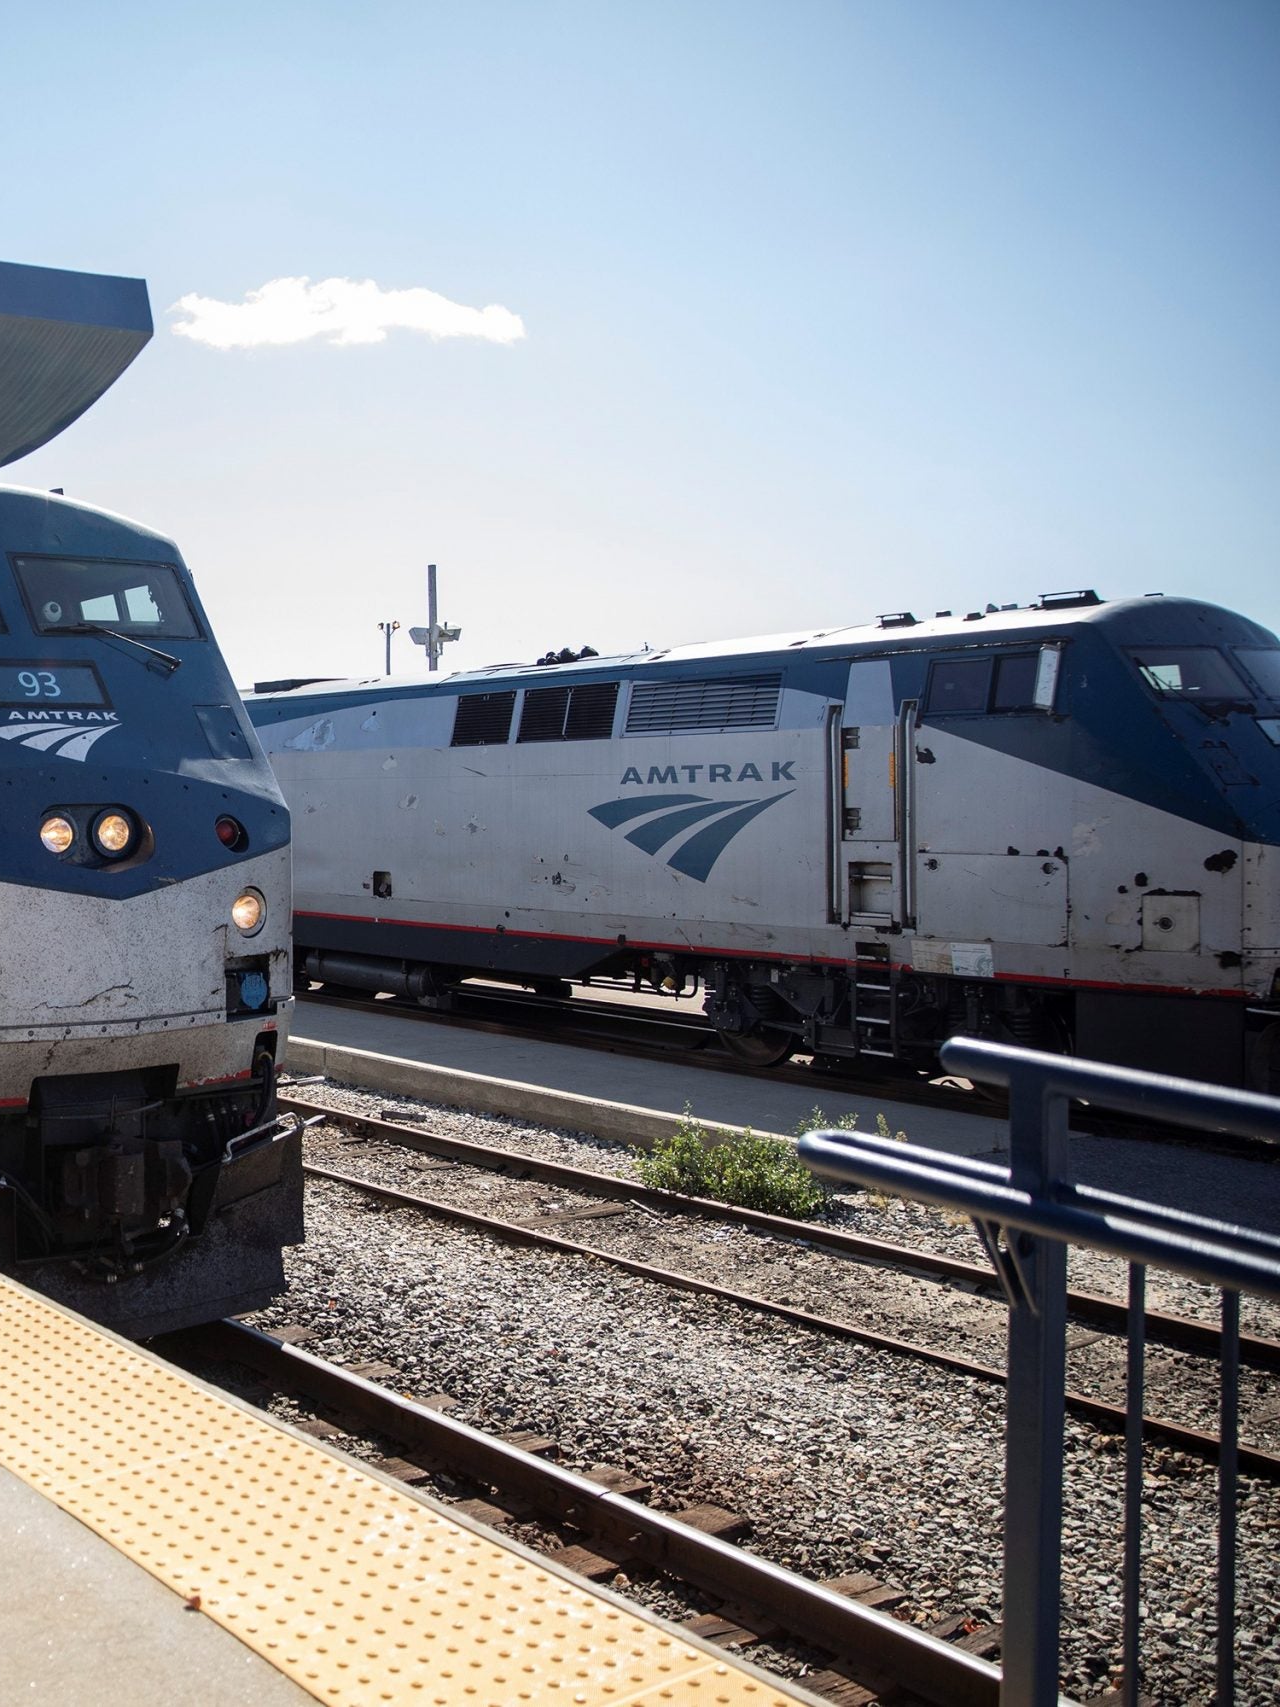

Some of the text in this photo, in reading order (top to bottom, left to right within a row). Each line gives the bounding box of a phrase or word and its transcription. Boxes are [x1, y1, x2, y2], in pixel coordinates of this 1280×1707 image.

[18, 672, 61, 697] 93
[8, 711, 119, 721] AMTRAK
[620, 761, 796, 785] AMTRAK
